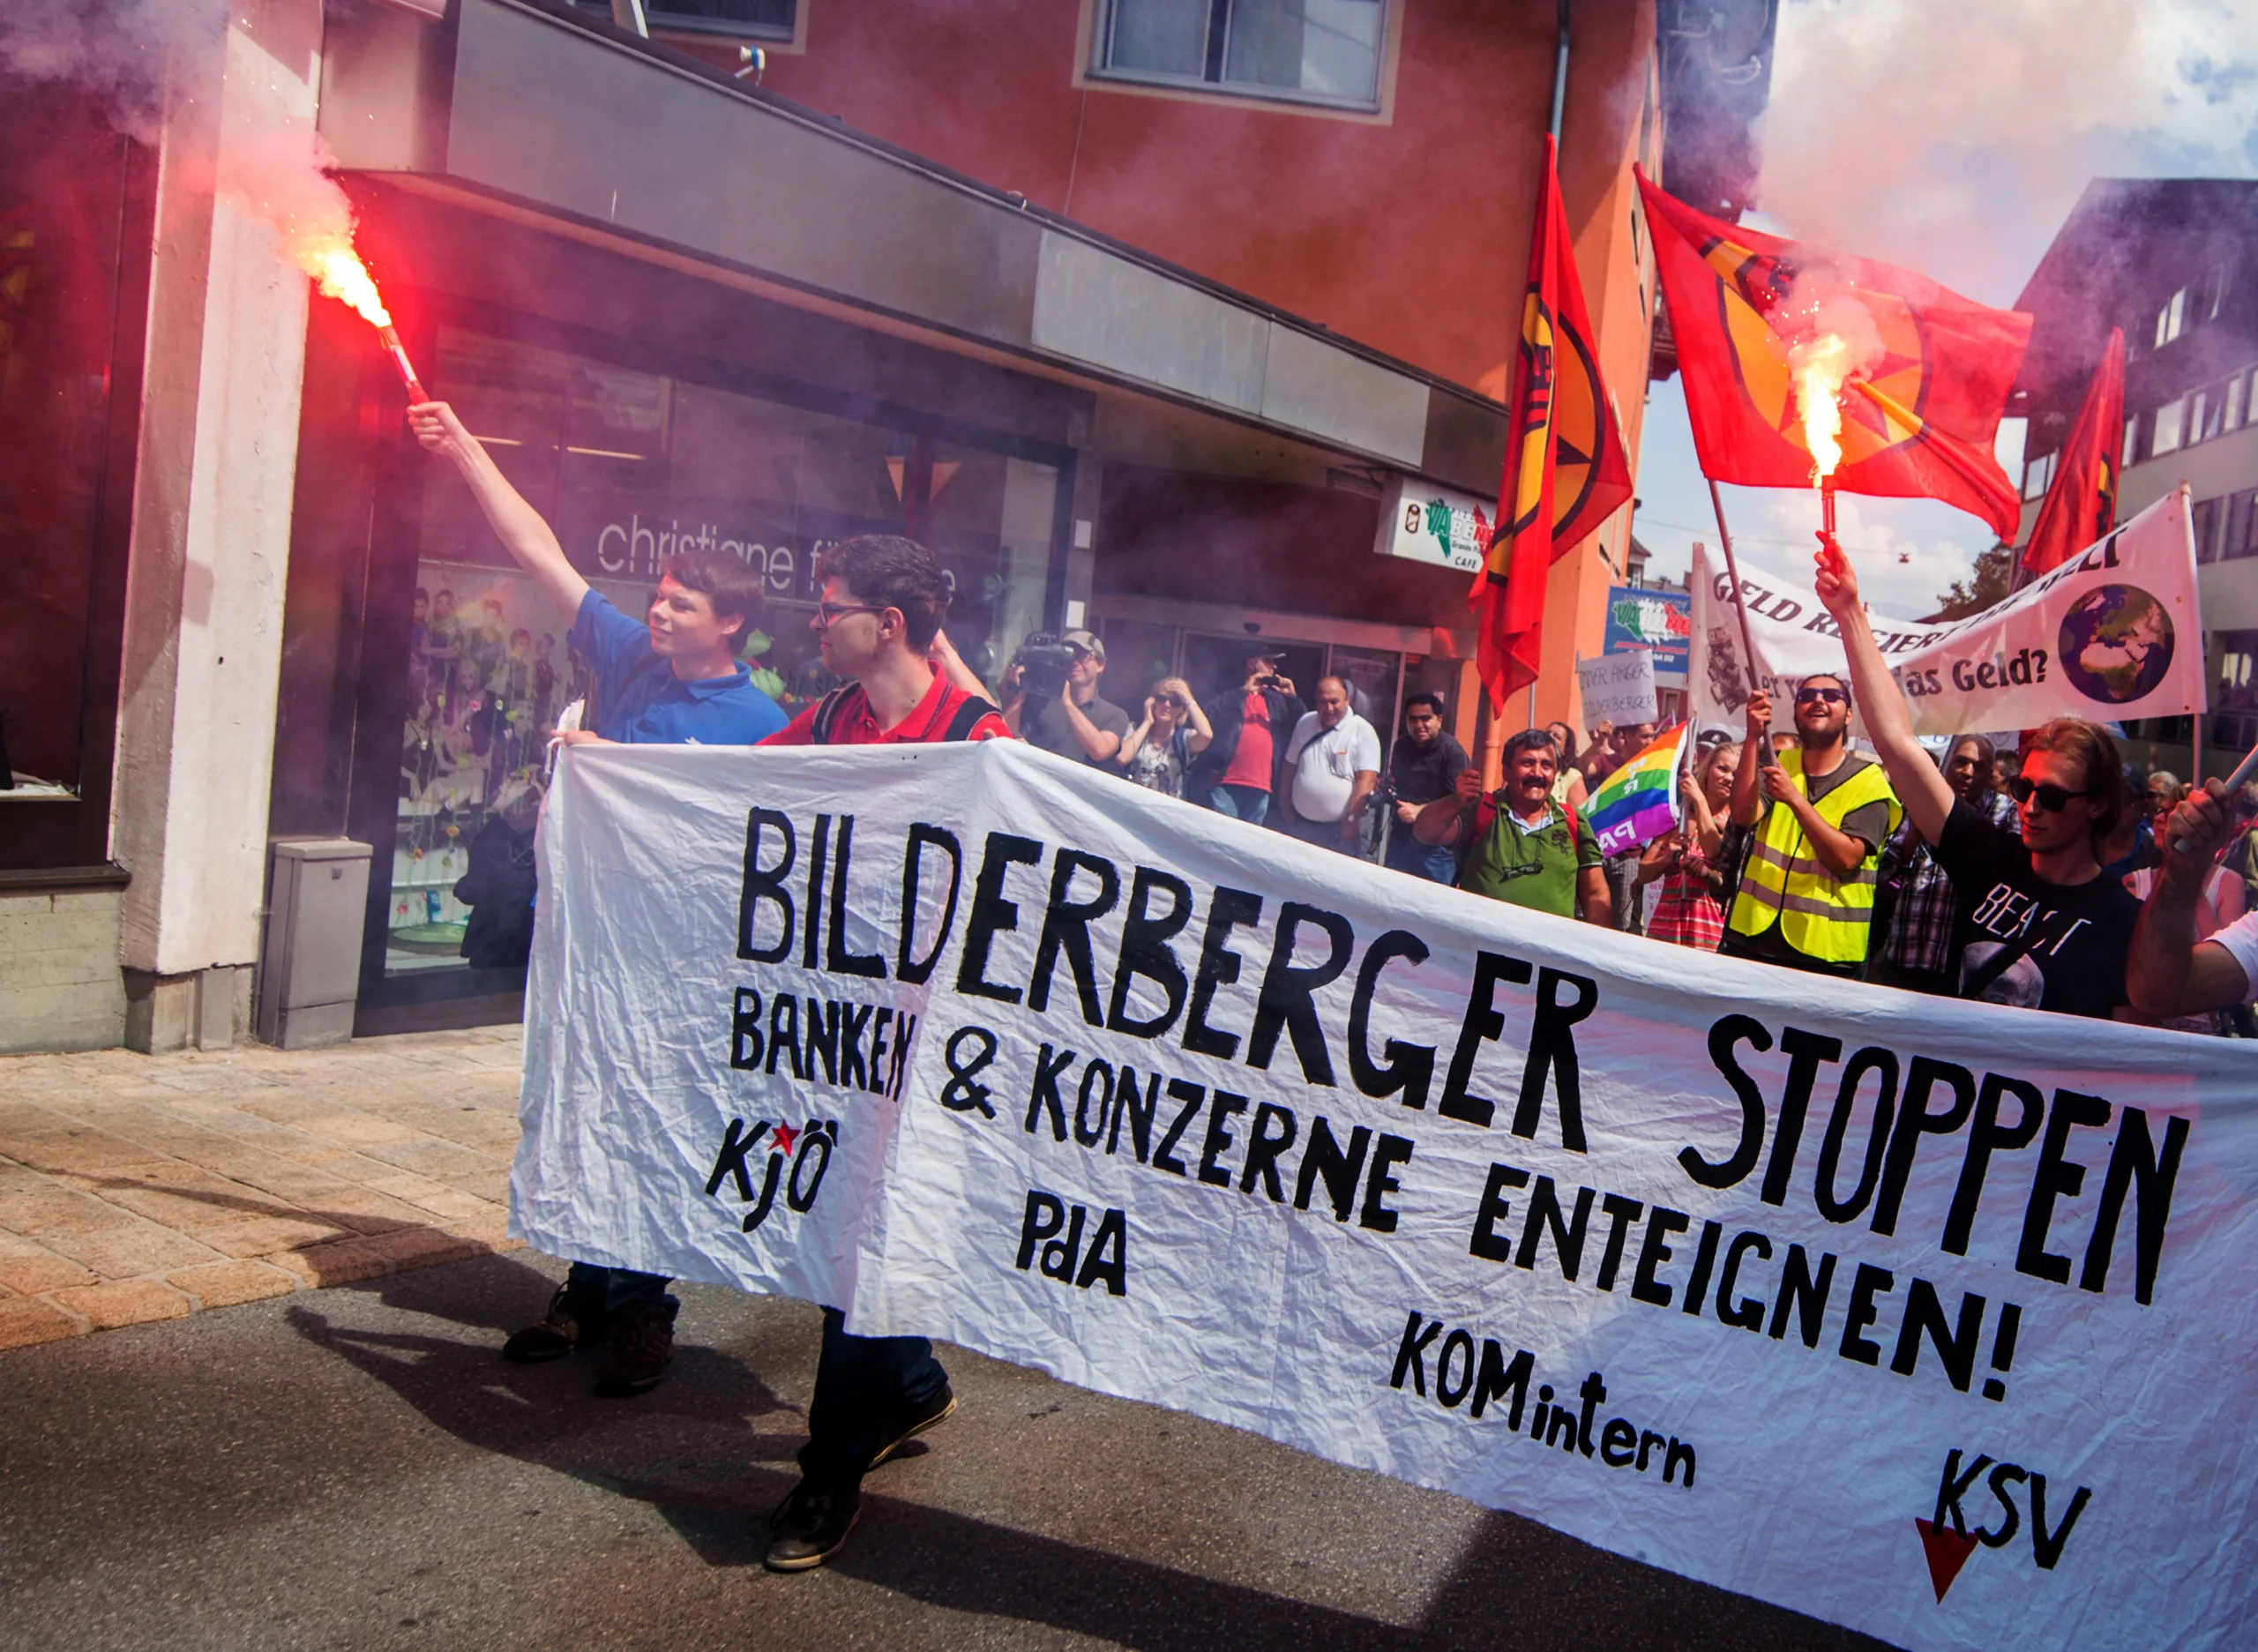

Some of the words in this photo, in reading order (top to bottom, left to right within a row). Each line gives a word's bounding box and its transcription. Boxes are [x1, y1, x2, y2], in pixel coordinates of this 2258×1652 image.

[1455, 557, 1477, 569] CAFE
[1713, 572, 1802, 622] GELD
[1952, 648, 2048, 692] Geld?
[736, 806, 1598, 1154] BILDERBERGER
[1677, 1014, 2190, 1306] STOPPEN
[730, 987, 916, 1103] BANKEN
[940, 1027, 998, 1119] &
[1025, 1043, 1415, 1233] KONZERNE
[1469, 1162, 2022, 1402] ENTEIGNEN!
[1016, 1189, 1126, 1297] PdA
[1390, 1311, 1696, 1488] KOMintern
[1932, 1448, 2092, 1570] KSV
